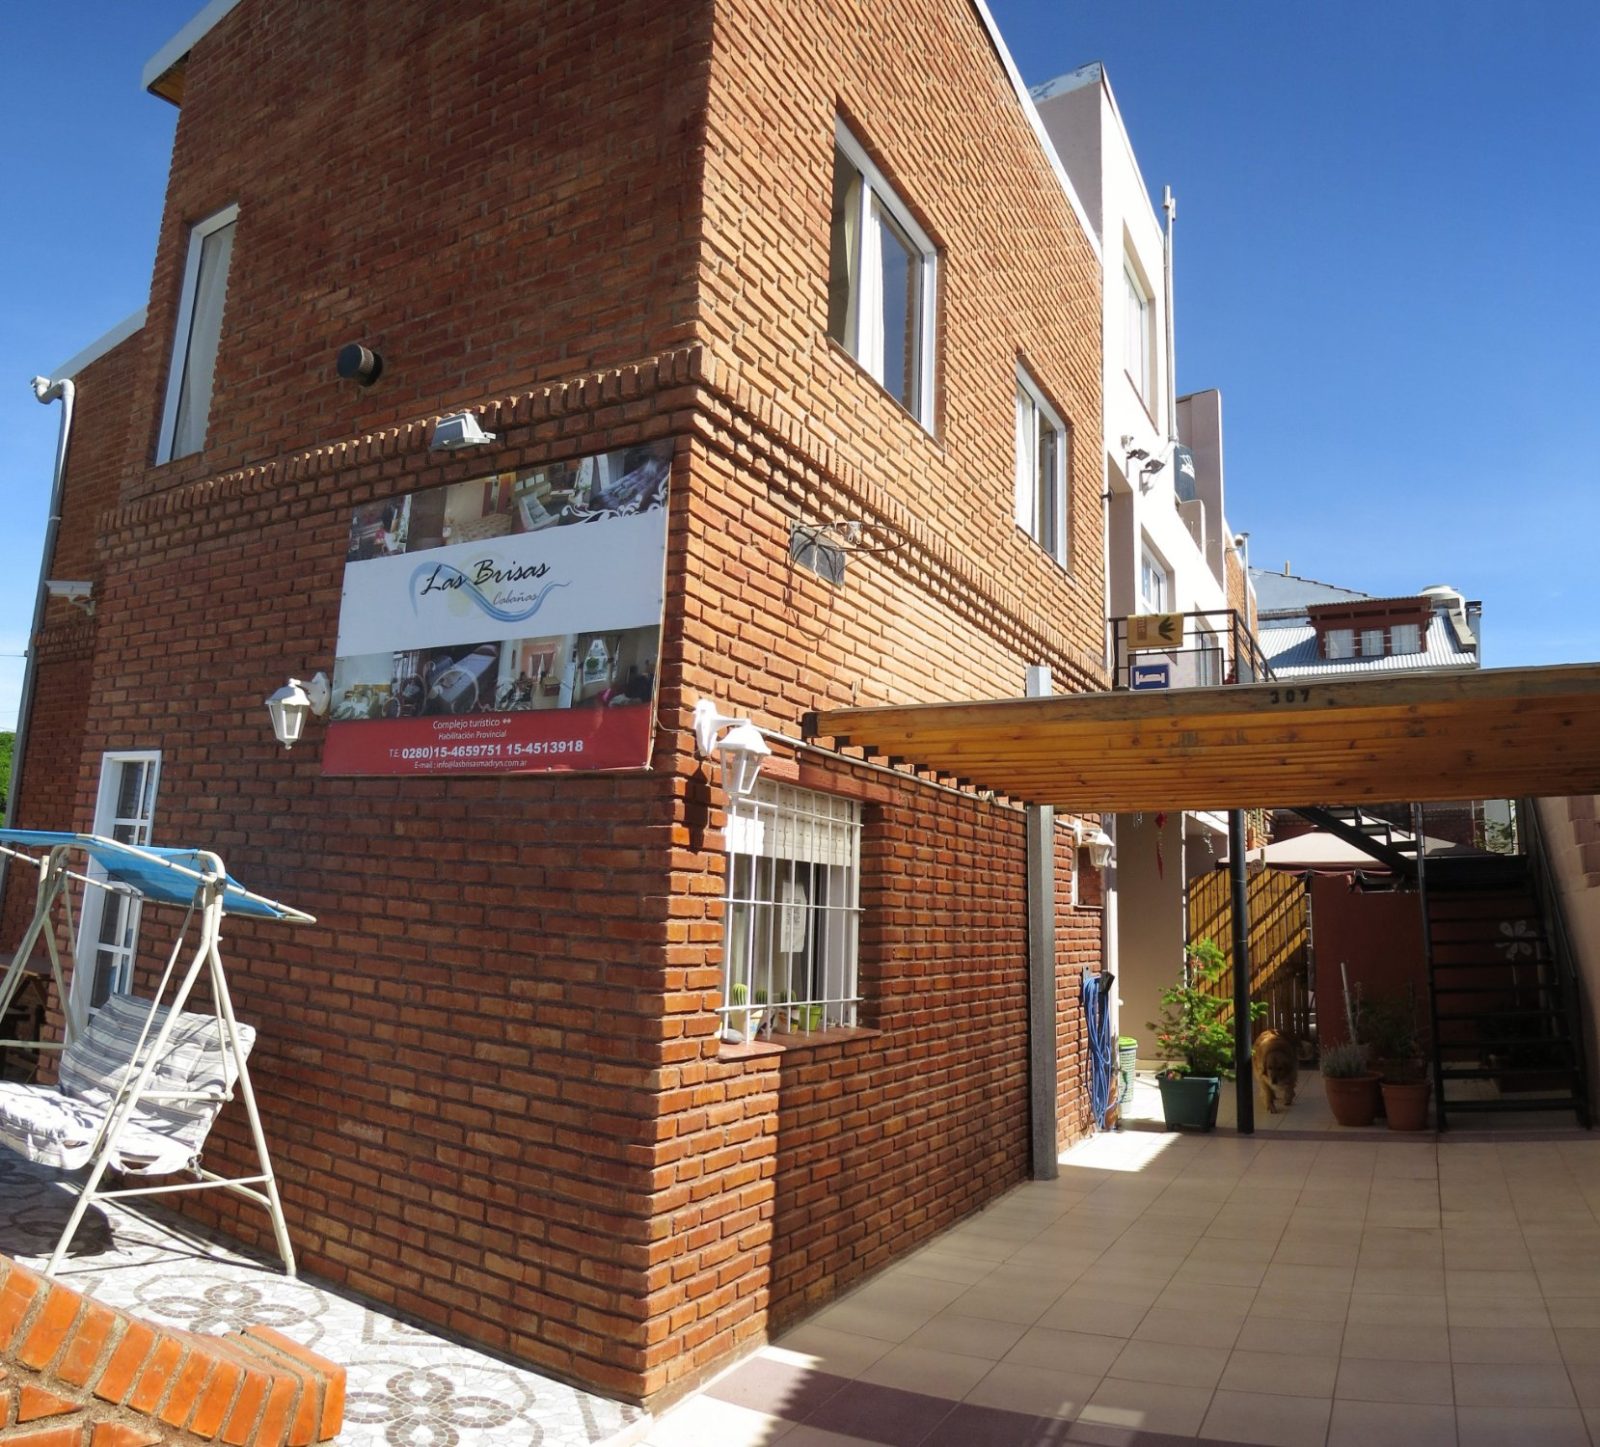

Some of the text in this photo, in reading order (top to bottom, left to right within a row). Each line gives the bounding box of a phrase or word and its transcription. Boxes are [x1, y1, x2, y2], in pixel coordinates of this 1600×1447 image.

[420, 559, 551, 595] Las Brisas
[1270, 687, 1311, 704] 307
[432, 719, 469, 731] Complejo
[476, 729, 507, 739] Provincial
[401, 744, 501, 759] 0280)15-4659751
[506, 739, 584, 756] 15-4513918
